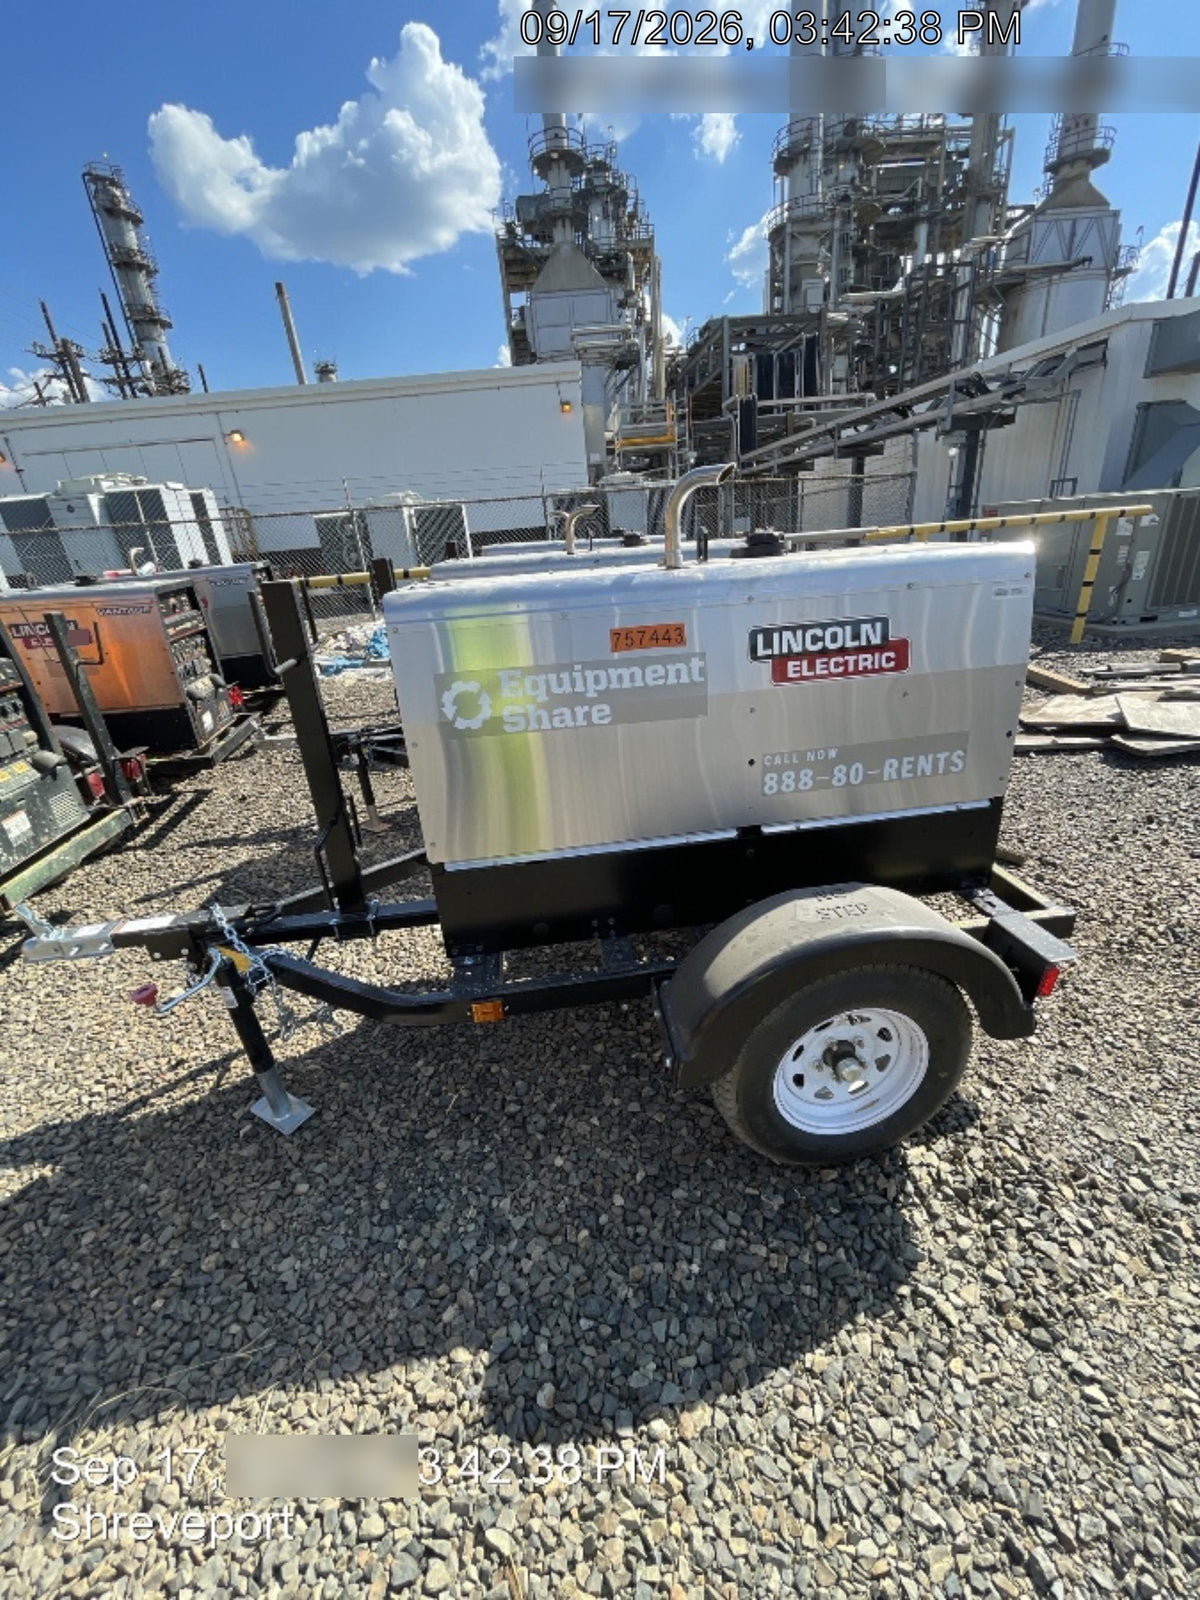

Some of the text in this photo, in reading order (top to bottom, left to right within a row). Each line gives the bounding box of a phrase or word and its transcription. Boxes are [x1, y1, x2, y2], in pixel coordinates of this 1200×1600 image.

[11, 620, 76, 638] LINCN
[611, 625, 685, 649] 757443
[756, 621, 883, 657] LINCOLN
[498, 655, 705, 703] Equipment
[786, 651, 897, 679] ELECTRIC
[501, 702, 613, 733] Share
[763, 747, 839, 767] CALL NOW
[763, 749, 966, 796] 888-80-RENTS
[815, 902, 869, 921] STEP
